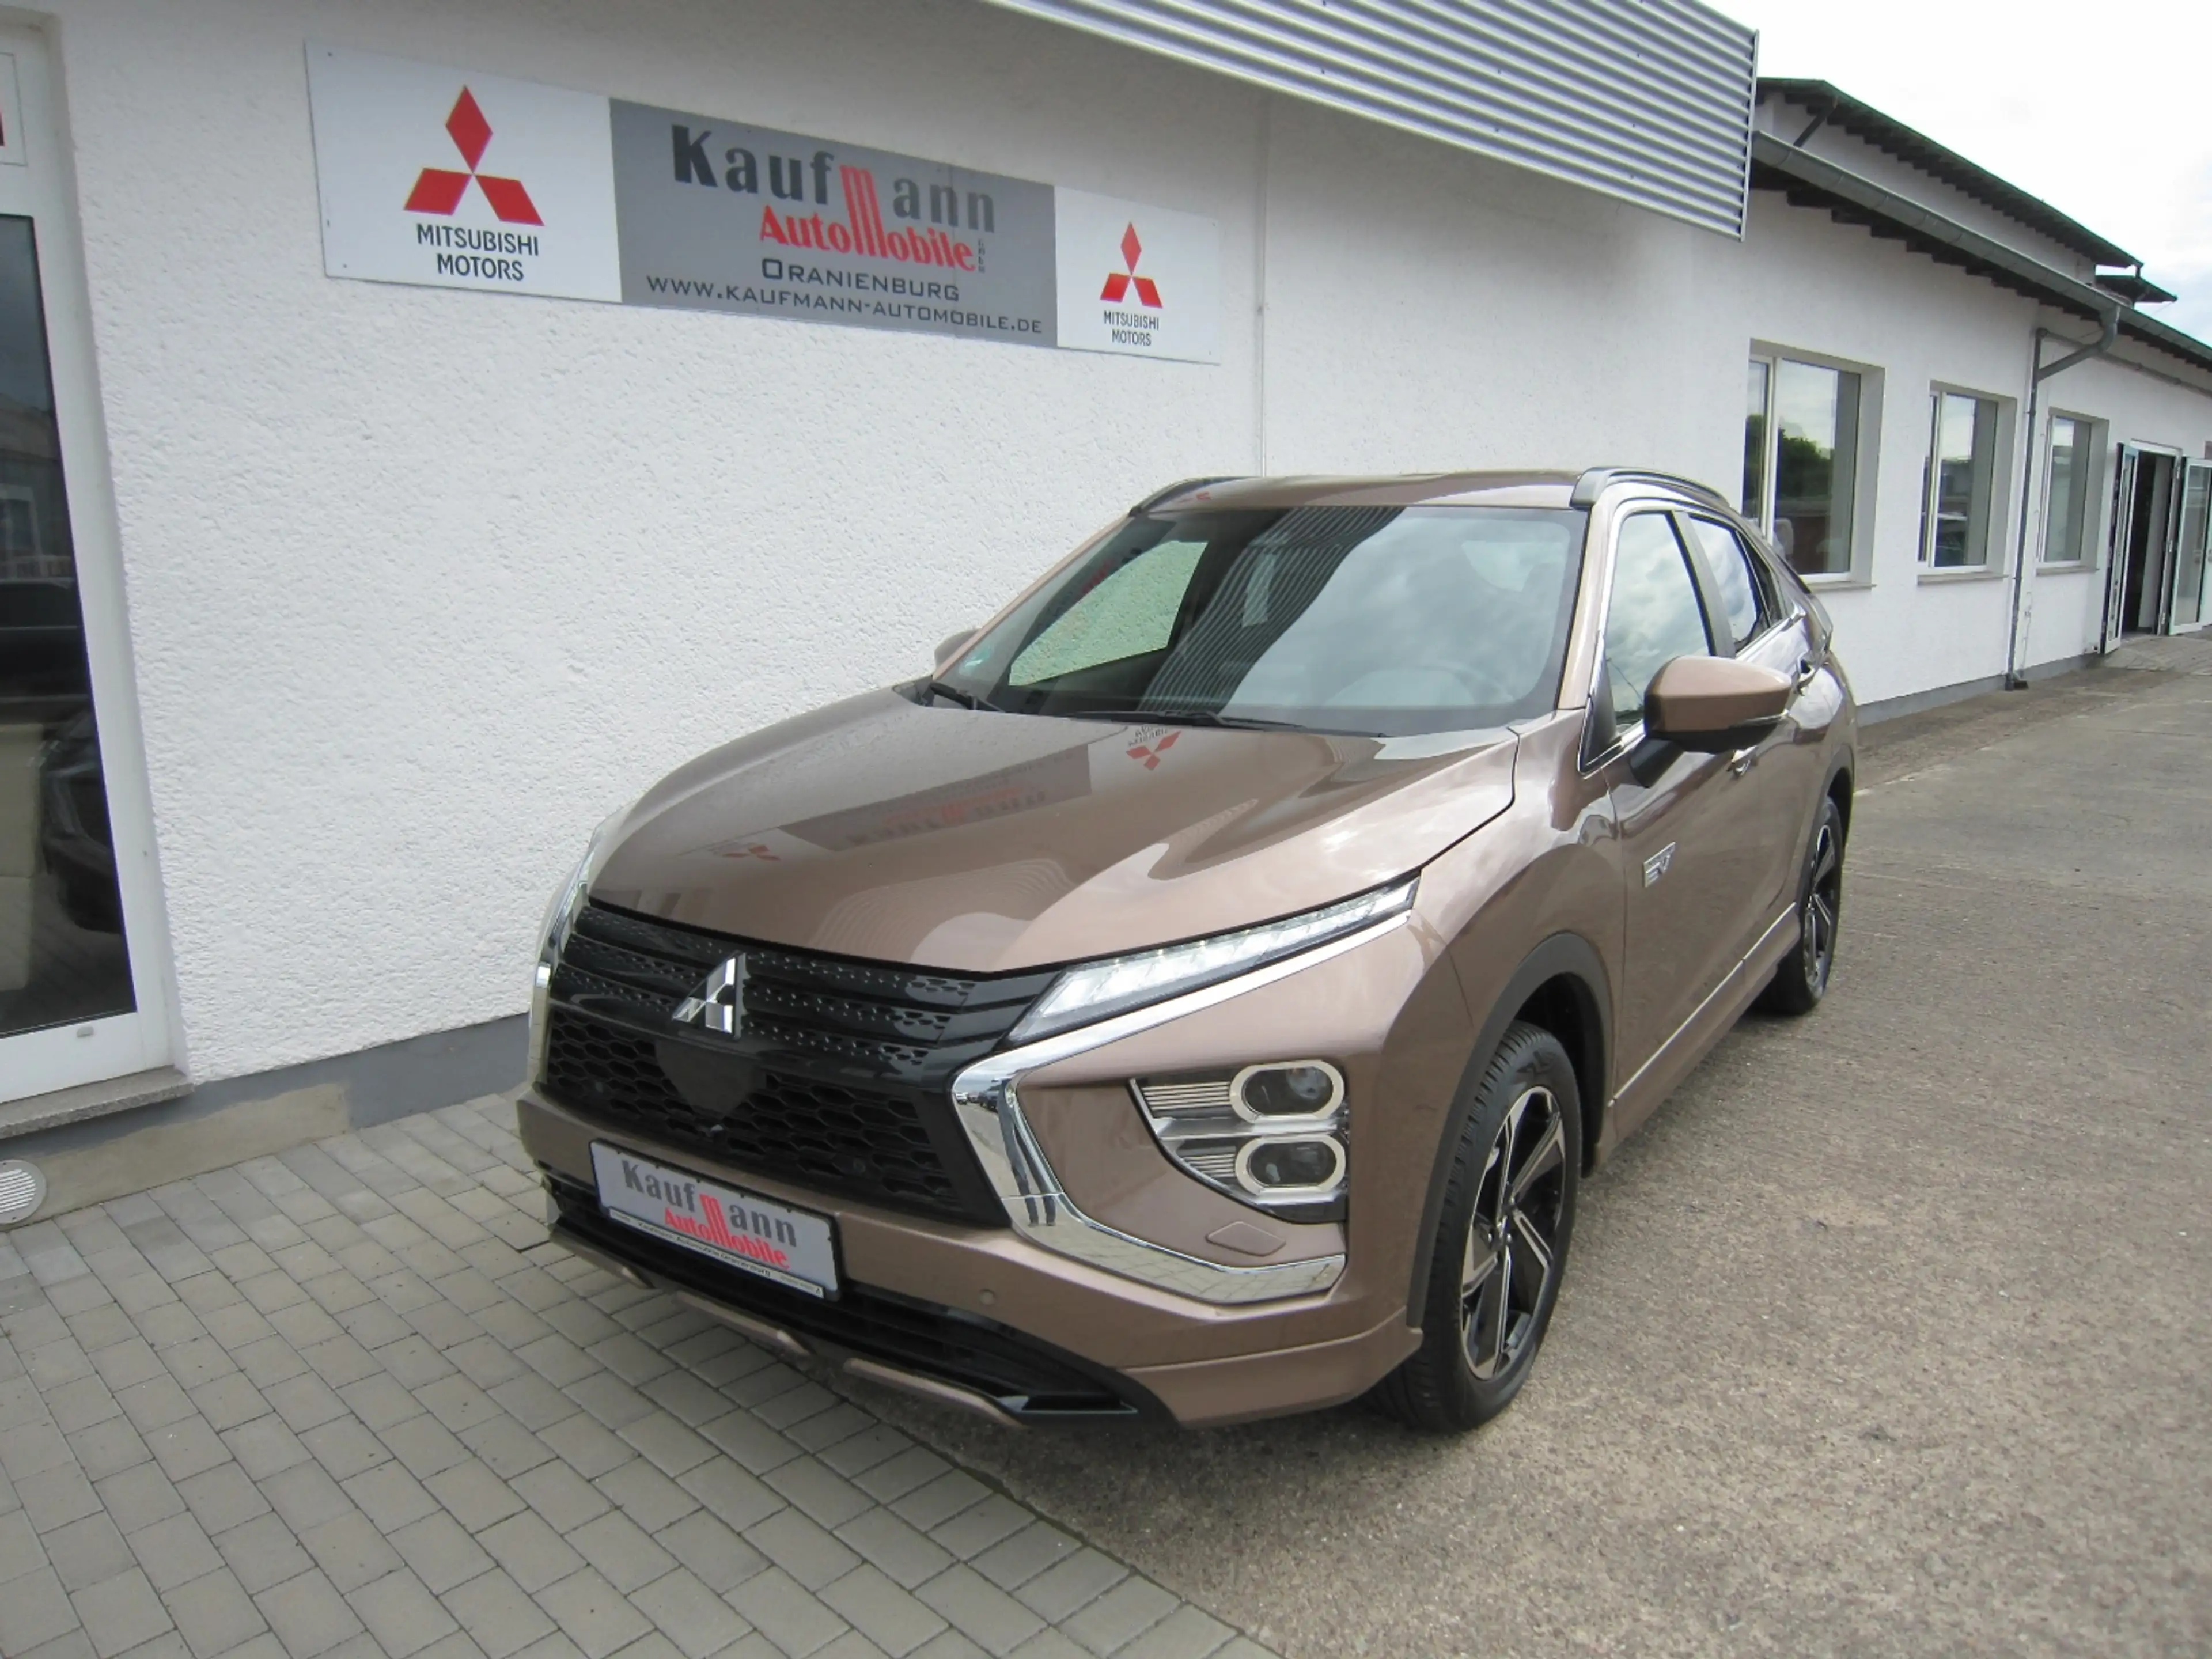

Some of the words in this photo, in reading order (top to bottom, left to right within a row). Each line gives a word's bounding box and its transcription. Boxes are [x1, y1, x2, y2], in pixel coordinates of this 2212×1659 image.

[671, 124, 995, 234] Kaufmann
[416, 223, 539, 256] MITSUBISHI
[436, 253, 525, 281] MOTORS
[646, 275, 1043, 334] WWW.KAUFMANN-AUTOMOBILE.DE
[1104, 310, 1159, 330] MITSUBISHI
[1112, 329, 1152, 346] MOTORS
[622, 1159, 797, 1248] Kaufmann
